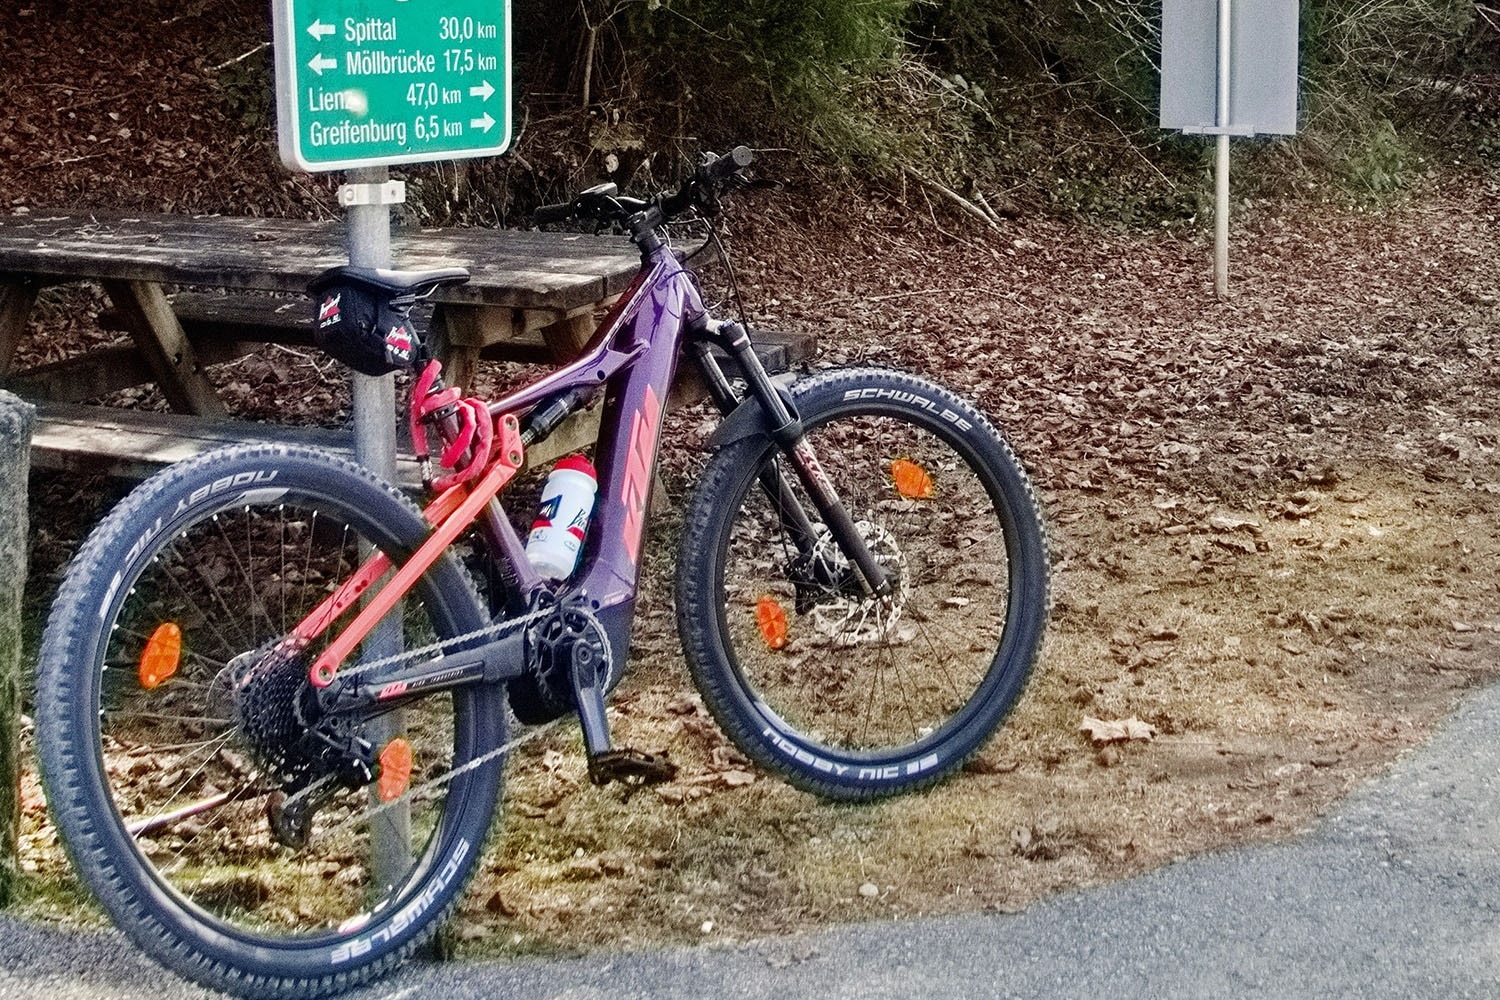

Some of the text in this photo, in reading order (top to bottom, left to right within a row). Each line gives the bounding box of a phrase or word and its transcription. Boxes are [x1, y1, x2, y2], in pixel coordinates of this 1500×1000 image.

[344, 16, 496, 46] Spittal 30,0 km
[346, 49, 496, 75] Möllbrücke 17,5 km
[406, 82, 438, 110] 47,0
[442, 88, 462, 104] km
[310, 115, 463, 146] Greifenburg 6,5 km
[843, 388, 972, 432] SCHWALBE
[331, 837, 470, 964] SCHWALBE
